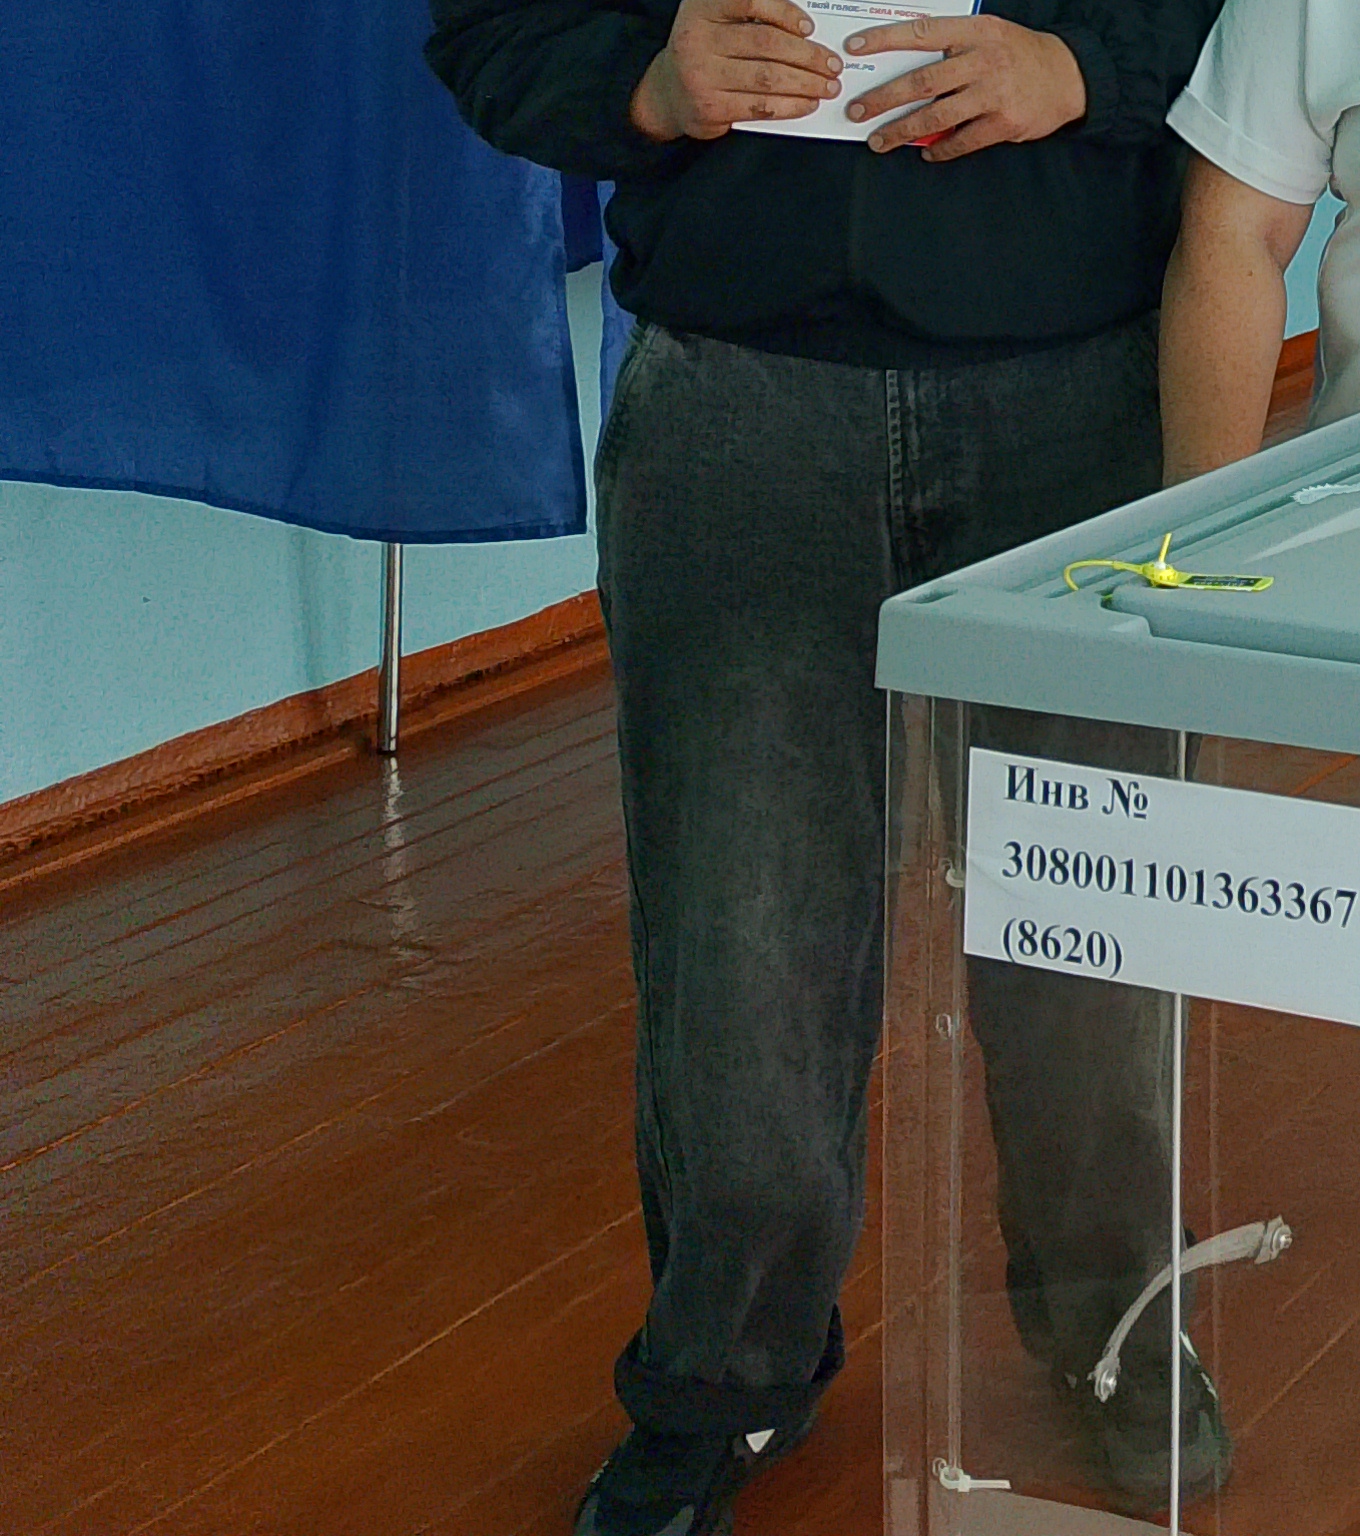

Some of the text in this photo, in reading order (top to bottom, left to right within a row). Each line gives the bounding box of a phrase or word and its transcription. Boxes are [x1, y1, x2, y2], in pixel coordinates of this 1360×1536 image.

[1003, 763, 1149, 820] Инв №
[1001, 840, 1358, 929] 308001101363367
[1001, 917, 1124, 978] (8620)
